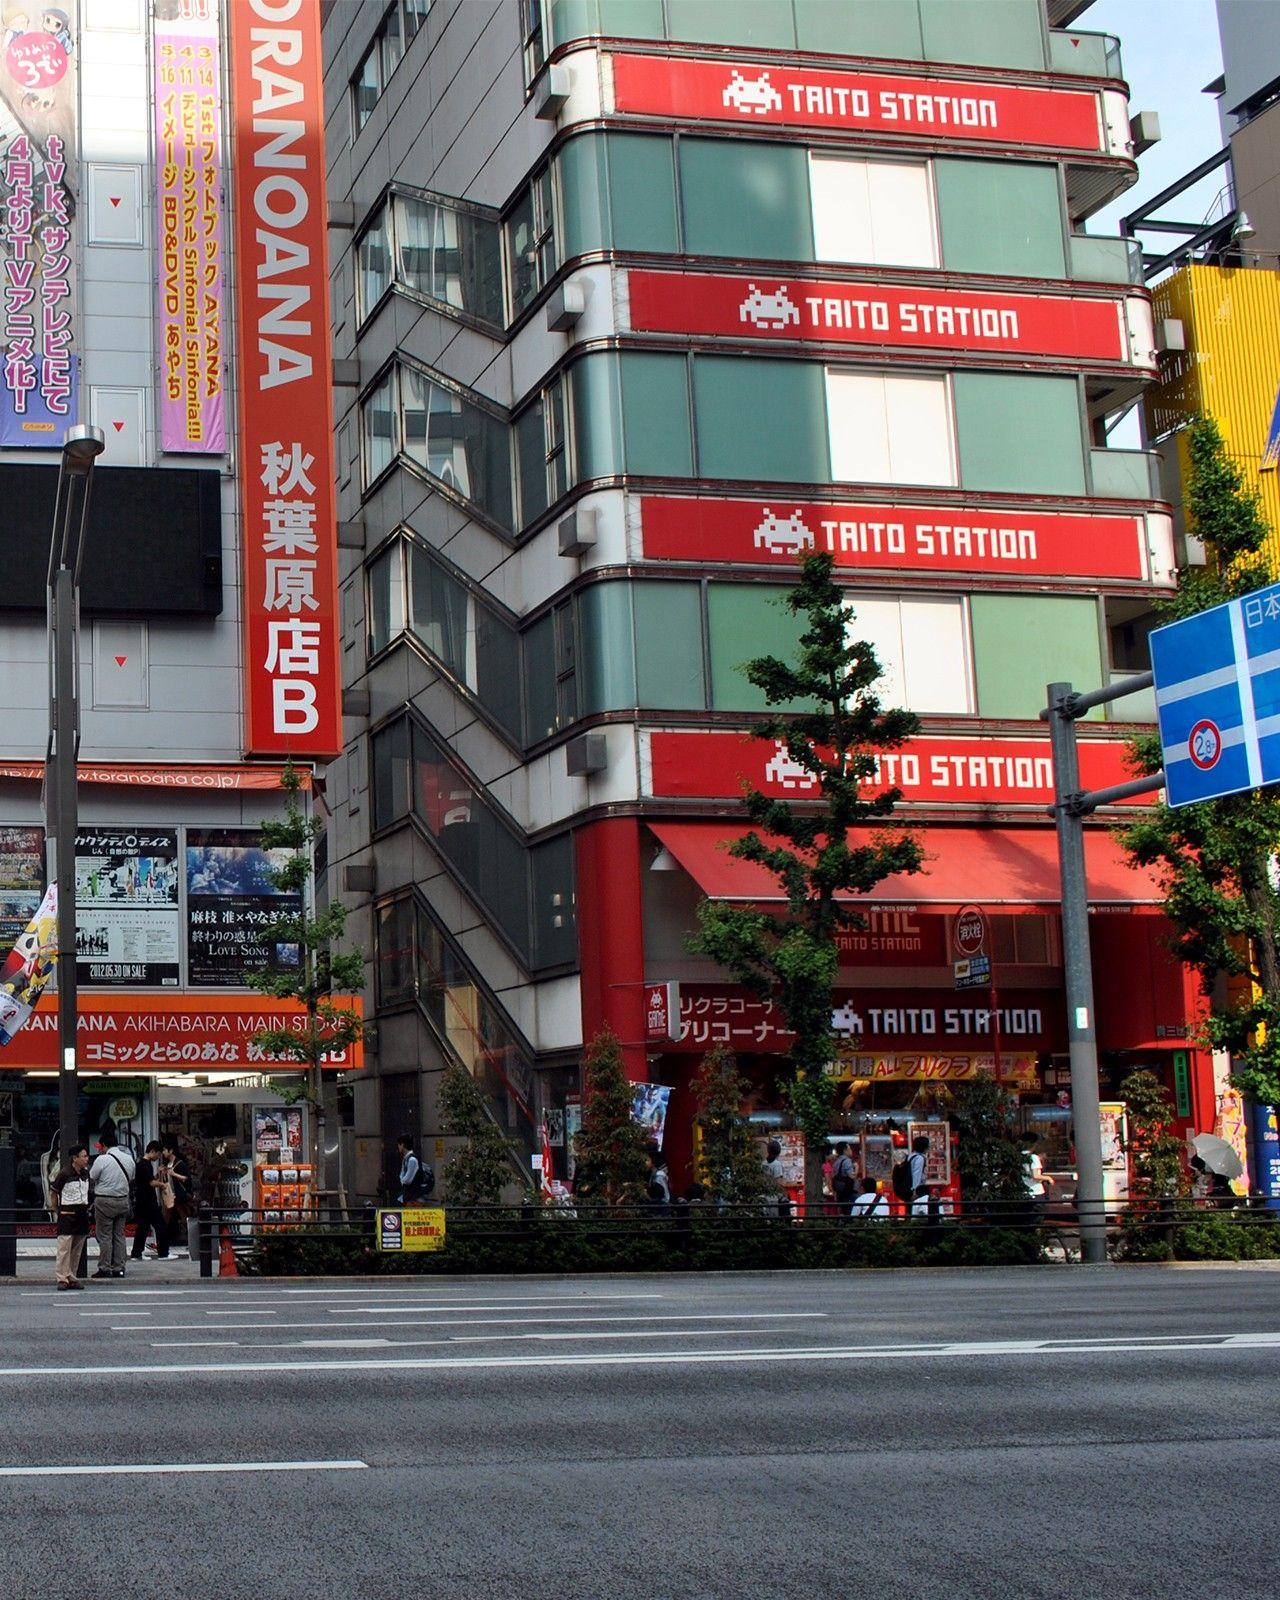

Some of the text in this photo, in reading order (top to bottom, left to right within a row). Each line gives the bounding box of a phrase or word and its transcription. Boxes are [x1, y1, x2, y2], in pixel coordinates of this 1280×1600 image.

[788, 82, 997, 128] TAITO STATION
[40, 134, 72, 415] tvk、サンテレビにて
[165, 196, 179, 315] BD&DVD
[805, 295, 1019, 340] TAITO STATION
[820, 520, 1037, 560] TAITO STATION
[259, 440, 321, 735] 秋葉原店B
[930, 755, 1054, 789] STATION
[871, 937, 922, 951] STATION
[123, 1015, 231, 1032] AKIHABARA
[237, 1015, 286, 1032] MAIN
[867, 1008, 1043, 1035] TAITO STATION
[86, 1041, 239, 1062] コミックとらのあな
